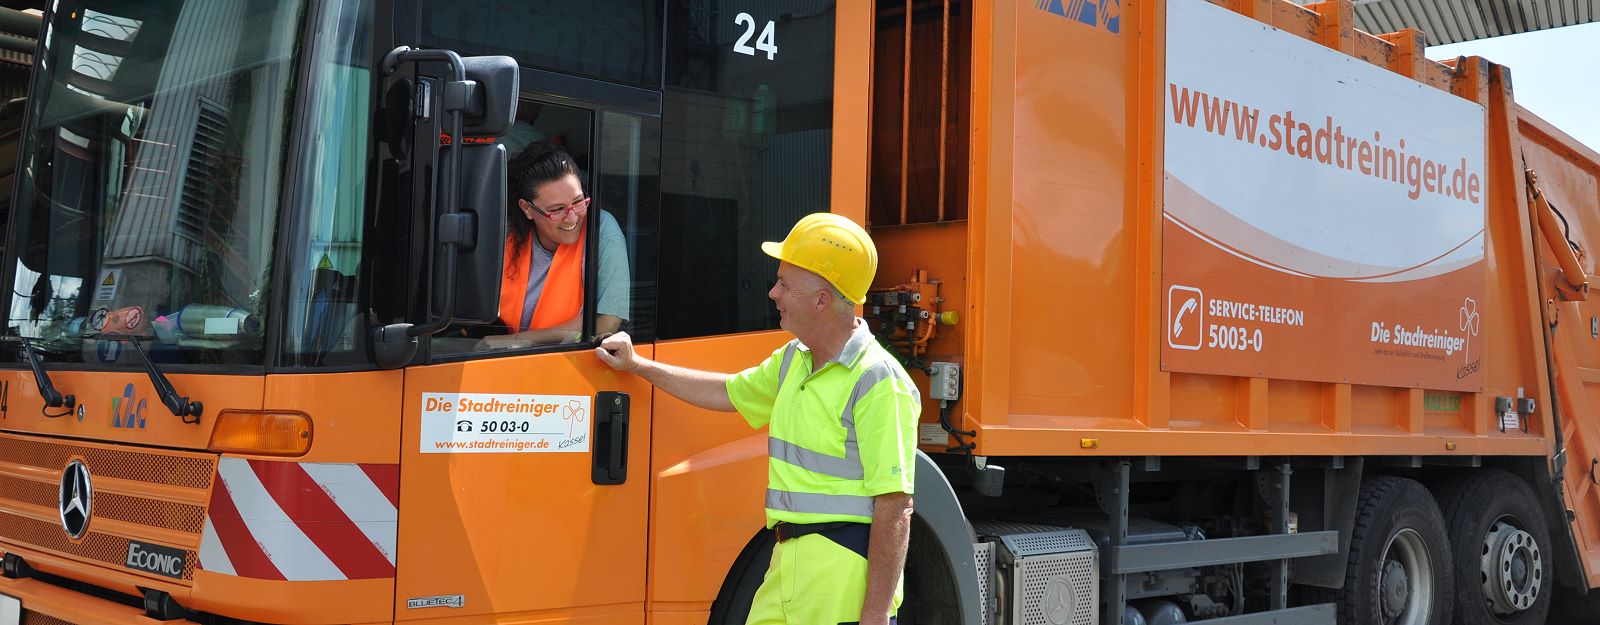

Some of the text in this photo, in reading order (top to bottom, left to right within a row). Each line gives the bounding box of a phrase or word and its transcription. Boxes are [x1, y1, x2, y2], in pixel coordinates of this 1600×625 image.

[733, 12, 778, 61] 24
[1170, 83, 1480, 204] www.stadtreiniger.de
[1209, 298, 1304, 327] SERVICE-TELEFON
[1208, 324, 1263, 352] 5003-0
[1371, 321, 1391, 343] Die
[1393, 324, 1465, 356] Stadtreiniger
[0, 380, 8, 419] 4
[425, 397, 559, 417] Die Stadtreiniger
[480, 421, 529, 433] 50 03-0
[558, 432, 586, 449] Kassel
[435, 438, 549, 451] www.stadtreiniger.de
